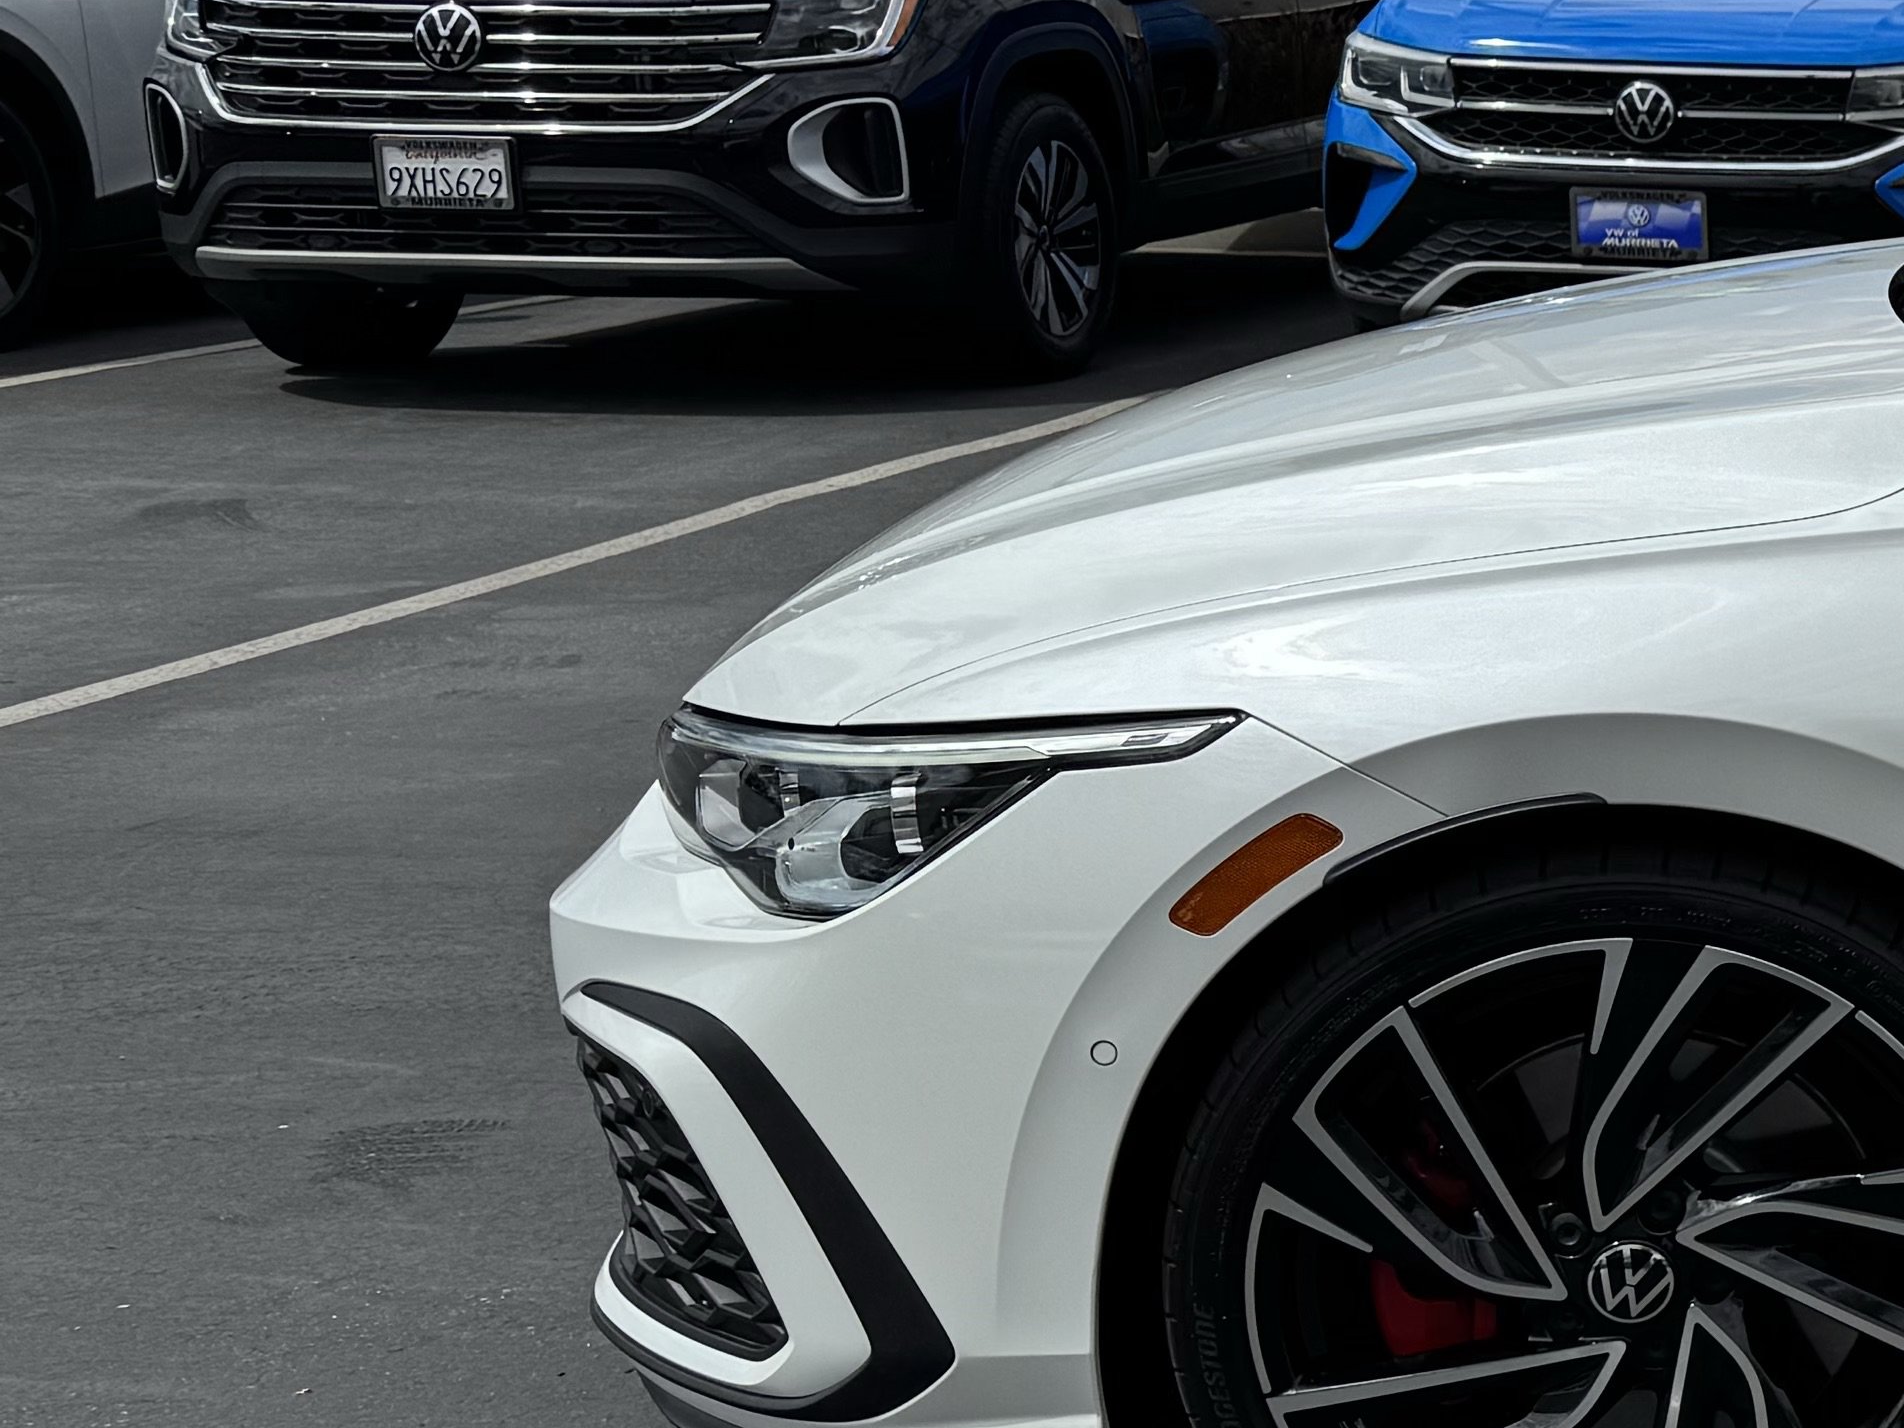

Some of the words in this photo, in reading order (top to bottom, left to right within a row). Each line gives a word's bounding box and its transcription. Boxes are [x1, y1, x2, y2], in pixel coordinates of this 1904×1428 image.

[388, 166, 503, 199] 9XHS629
[1605, 228, 1624, 237] VW
[1601, 238, 1679, 248] MURRIETA
